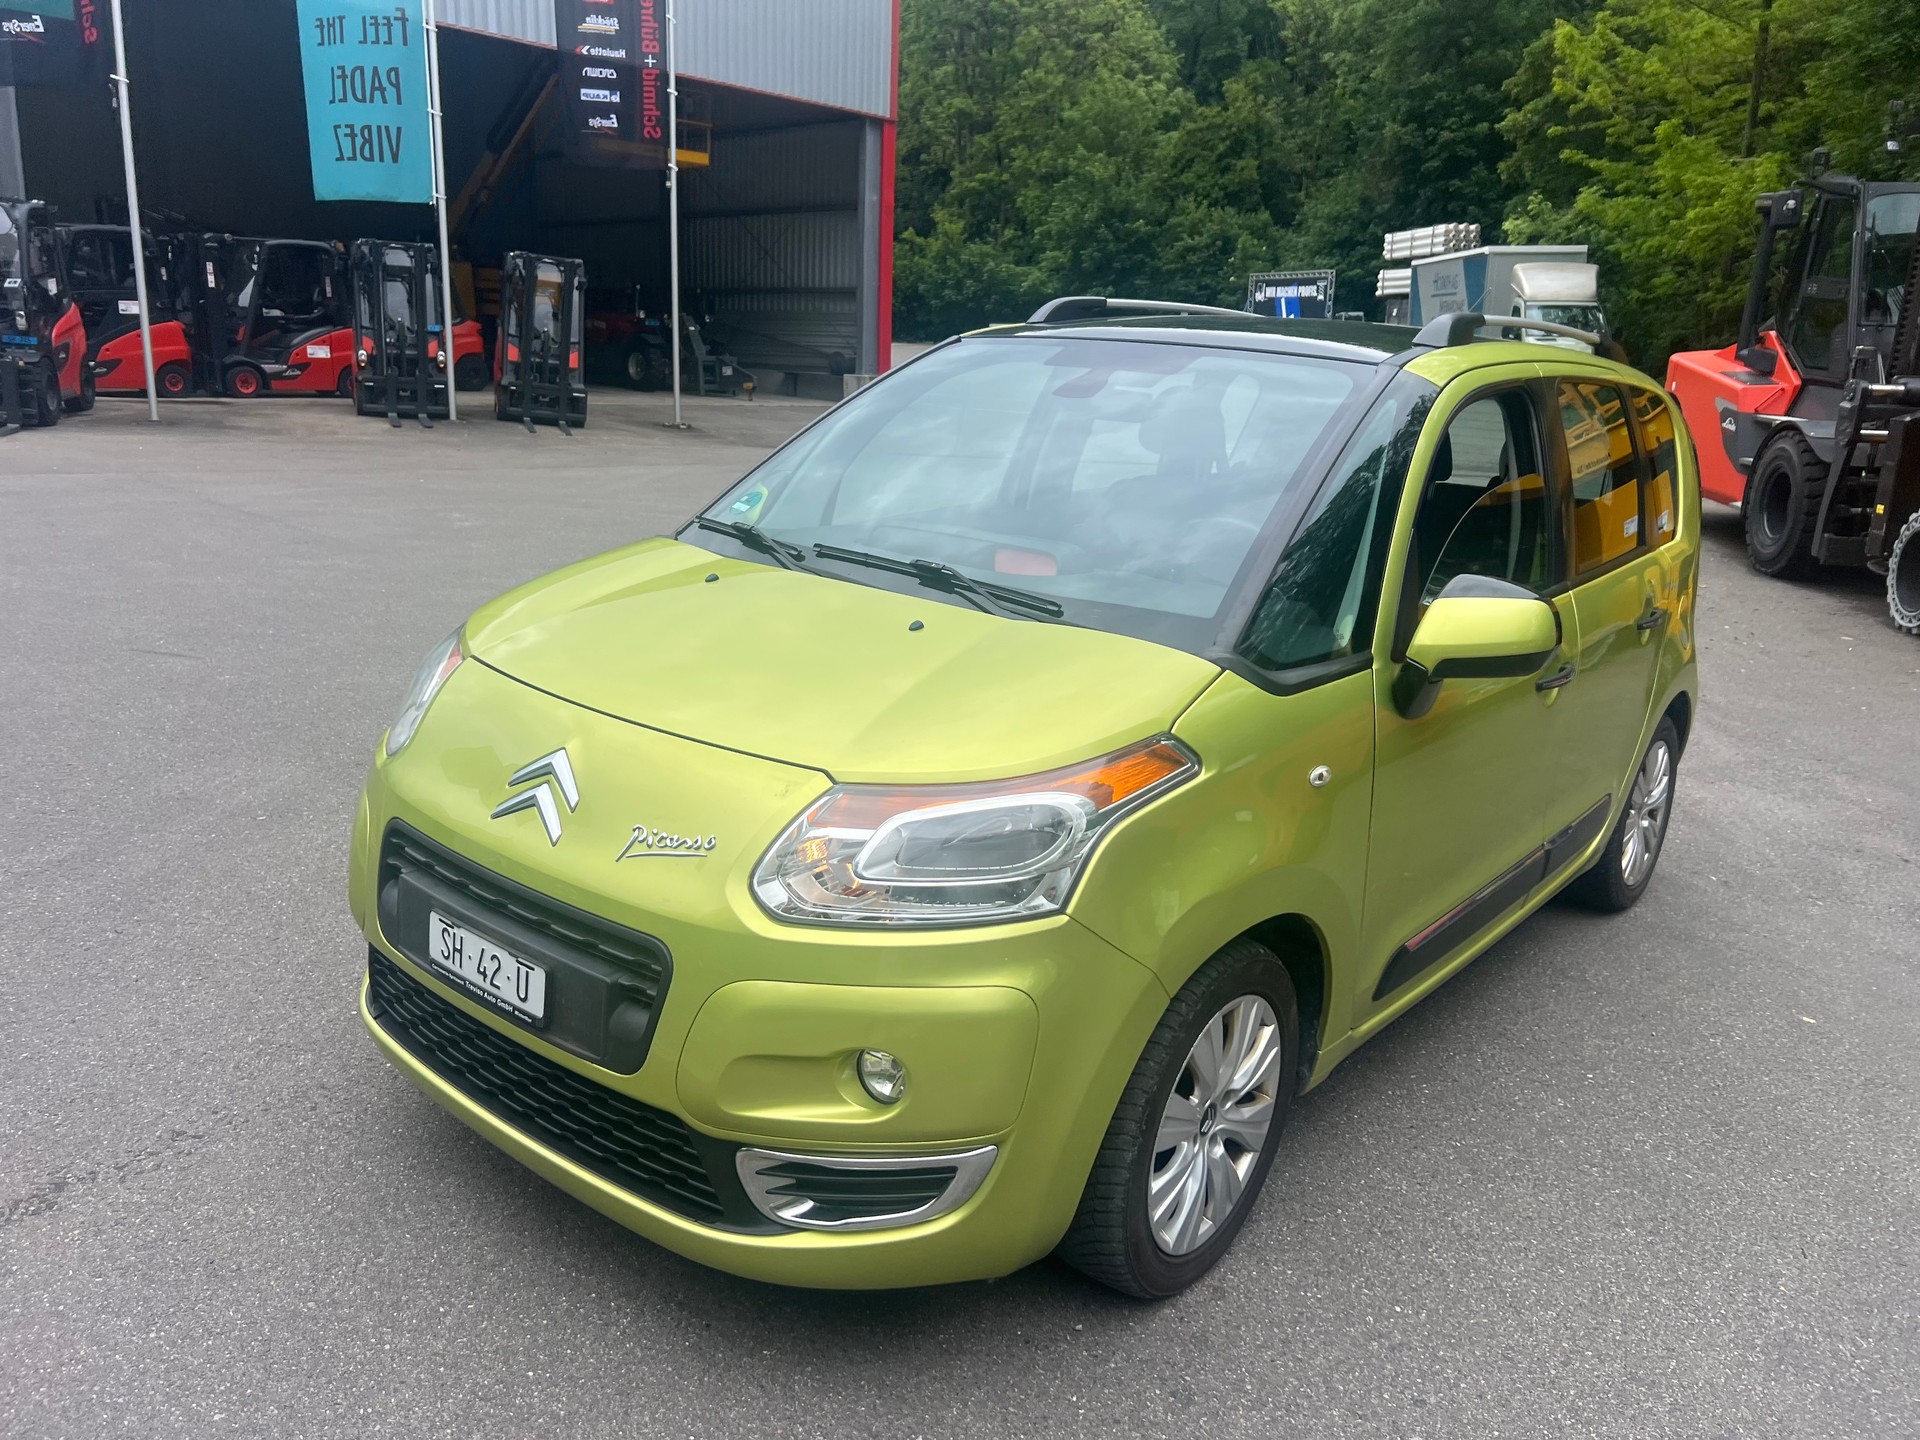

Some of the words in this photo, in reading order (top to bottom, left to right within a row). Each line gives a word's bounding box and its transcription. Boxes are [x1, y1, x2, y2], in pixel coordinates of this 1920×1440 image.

[615, 823, 717, 862] Picasso
[465, 980, 484, 996] Treviso
[484, 991, 496, 1004] Auto
[497, 999, 514, 1013] GmbH
